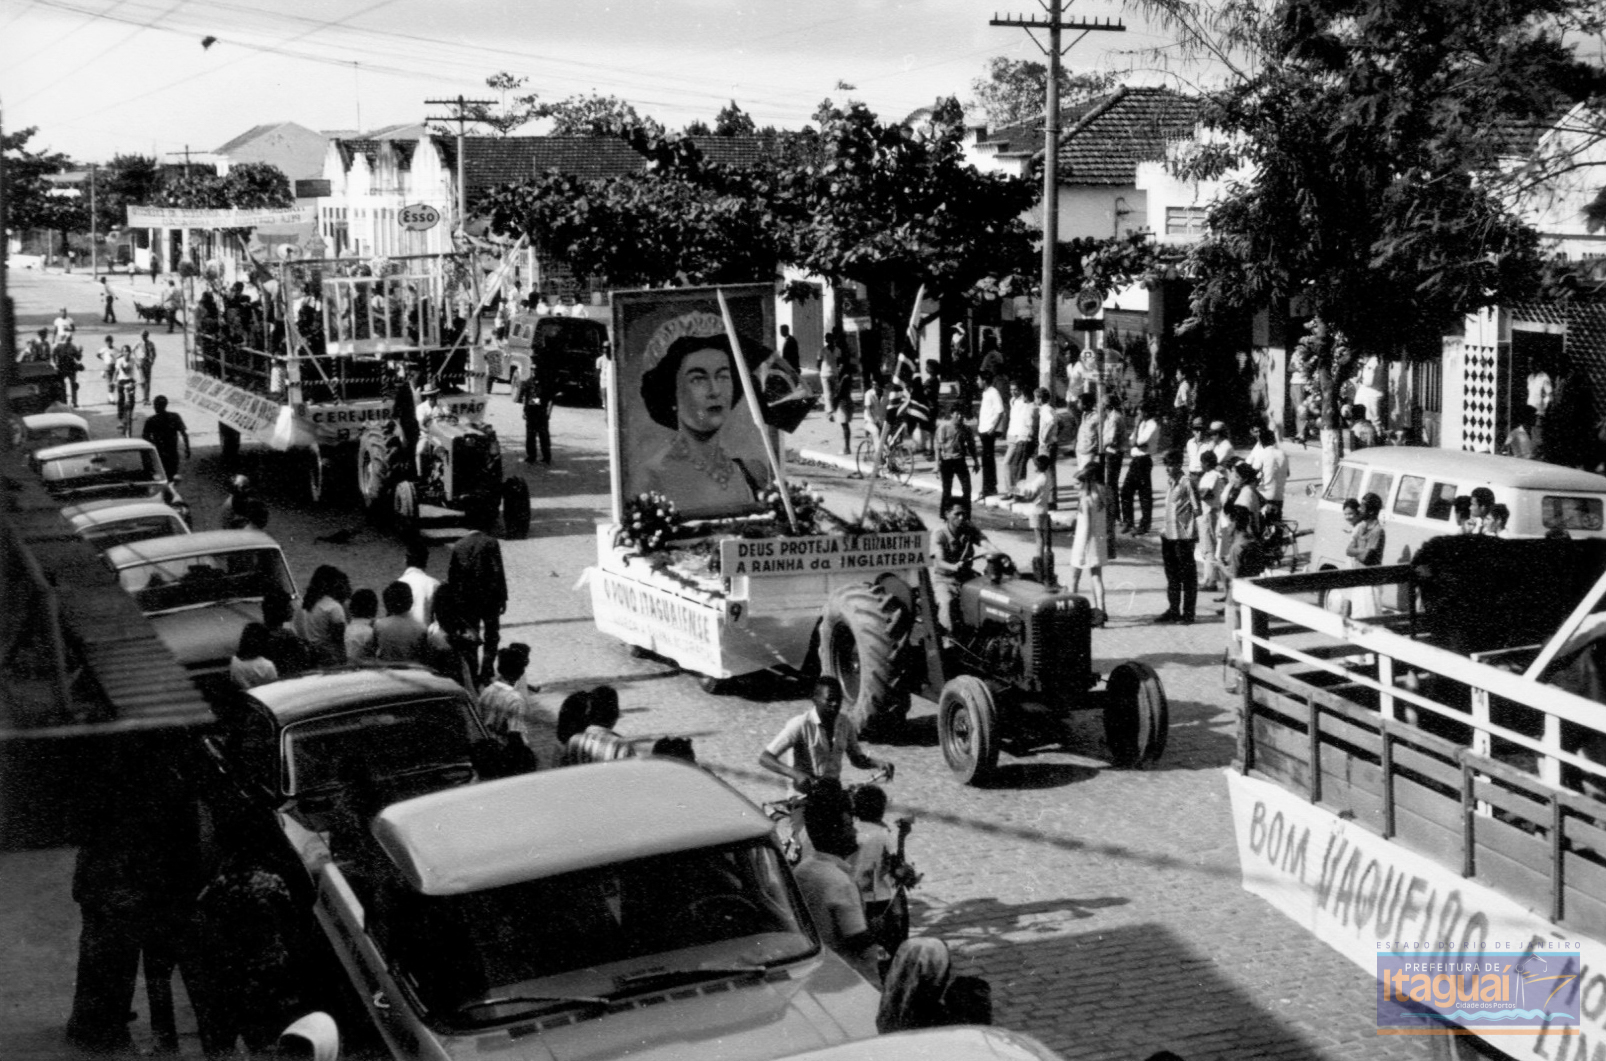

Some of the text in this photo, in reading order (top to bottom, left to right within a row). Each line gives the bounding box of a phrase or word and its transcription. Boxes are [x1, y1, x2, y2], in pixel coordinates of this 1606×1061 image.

[312, 398, 485, 423] CEREJEIR APÃO
[738, 543, 774, 558] DEUS
[780, 538, 839, 556] PROTEJA
[736, 552, 925, 574] A RAINHA da INGLATERRA
[730, 603, 743, 622] 9
[1249, 800, 1311, 884] BOM
[1316, 832, 1490, 994] VAQUEIRO
